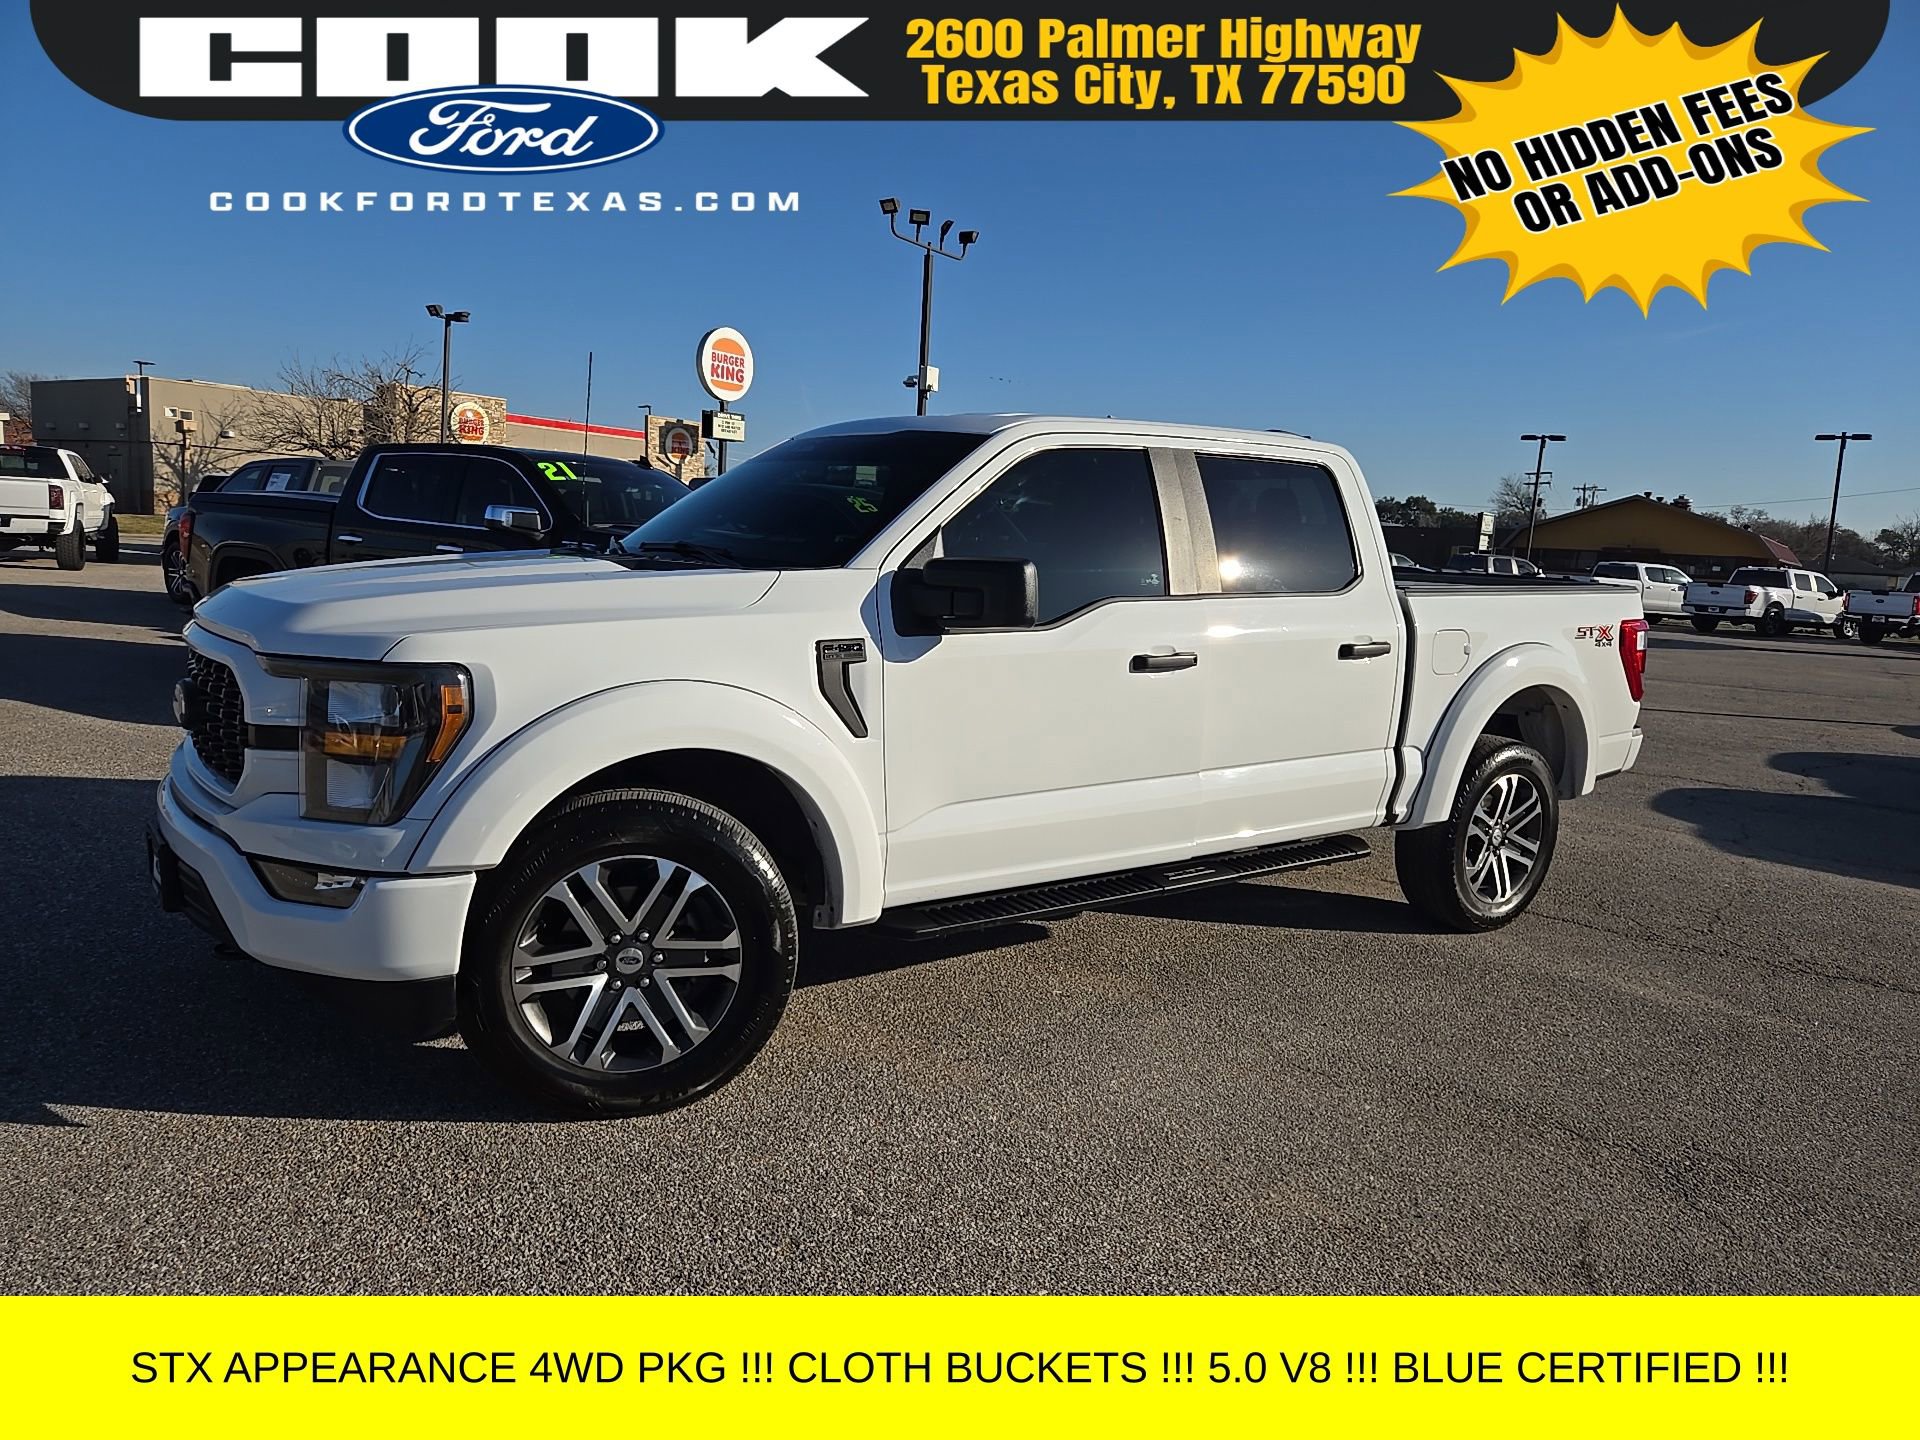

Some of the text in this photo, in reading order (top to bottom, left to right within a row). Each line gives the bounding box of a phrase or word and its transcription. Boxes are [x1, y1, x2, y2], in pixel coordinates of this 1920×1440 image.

[711, 351, 745, 369] BURGER
[710, 363, 745, 383] KING
[458, 424, 485, 436] KING
[537, 461, 578, 481] 21
[1574, 624, 1614, 642] STX
